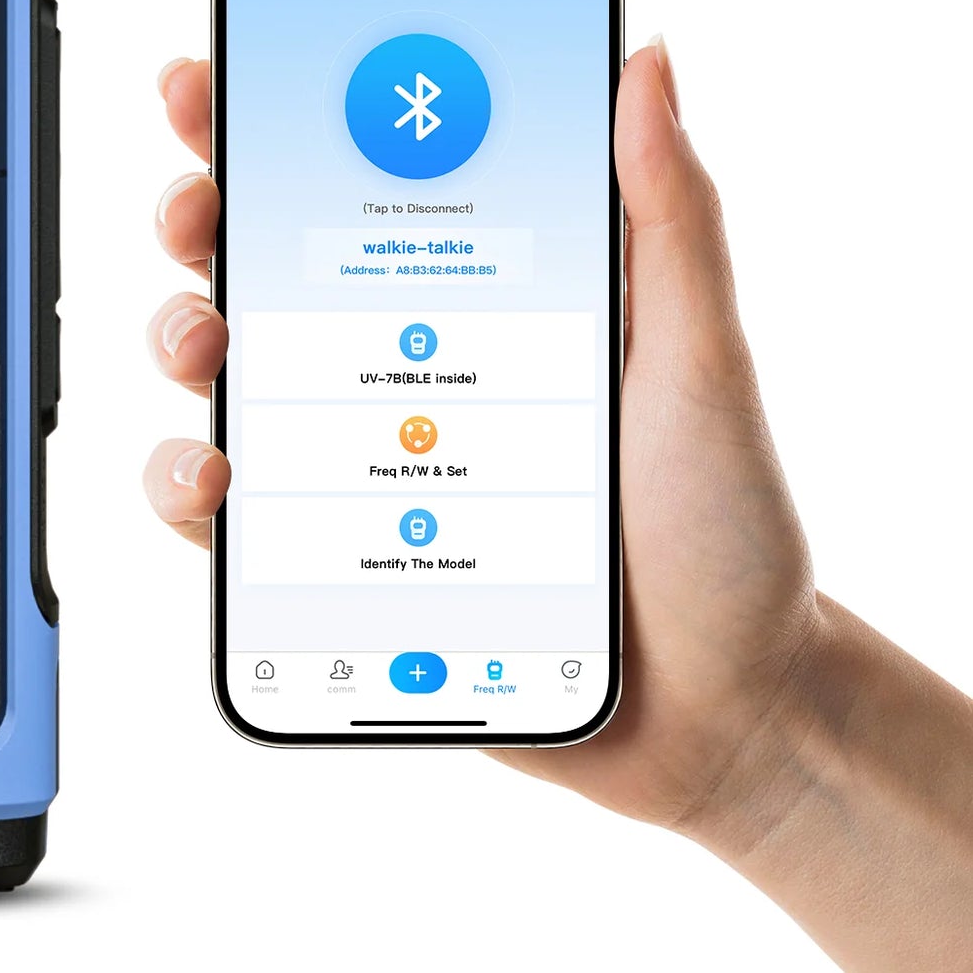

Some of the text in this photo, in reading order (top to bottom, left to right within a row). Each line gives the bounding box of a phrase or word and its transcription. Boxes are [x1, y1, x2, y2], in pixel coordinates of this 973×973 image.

[363, 203, 473, 215] (Tap to Disconnect)
[363, 240, 473, 254] walkie-talkie
[396, 265, 496, 275] A8:B3:62:64:BB:B5)
[361, 372, 476, 384] UV-7B(BLE inside)
[370, 465, 467, 478] Freq R/W & Set
[361, 559, 475, 571] Identify The Model
[327, 686, 356, 694] comm
[474, 685, 516, 696] Freq R/W
[565, 685, 578, 696] My
